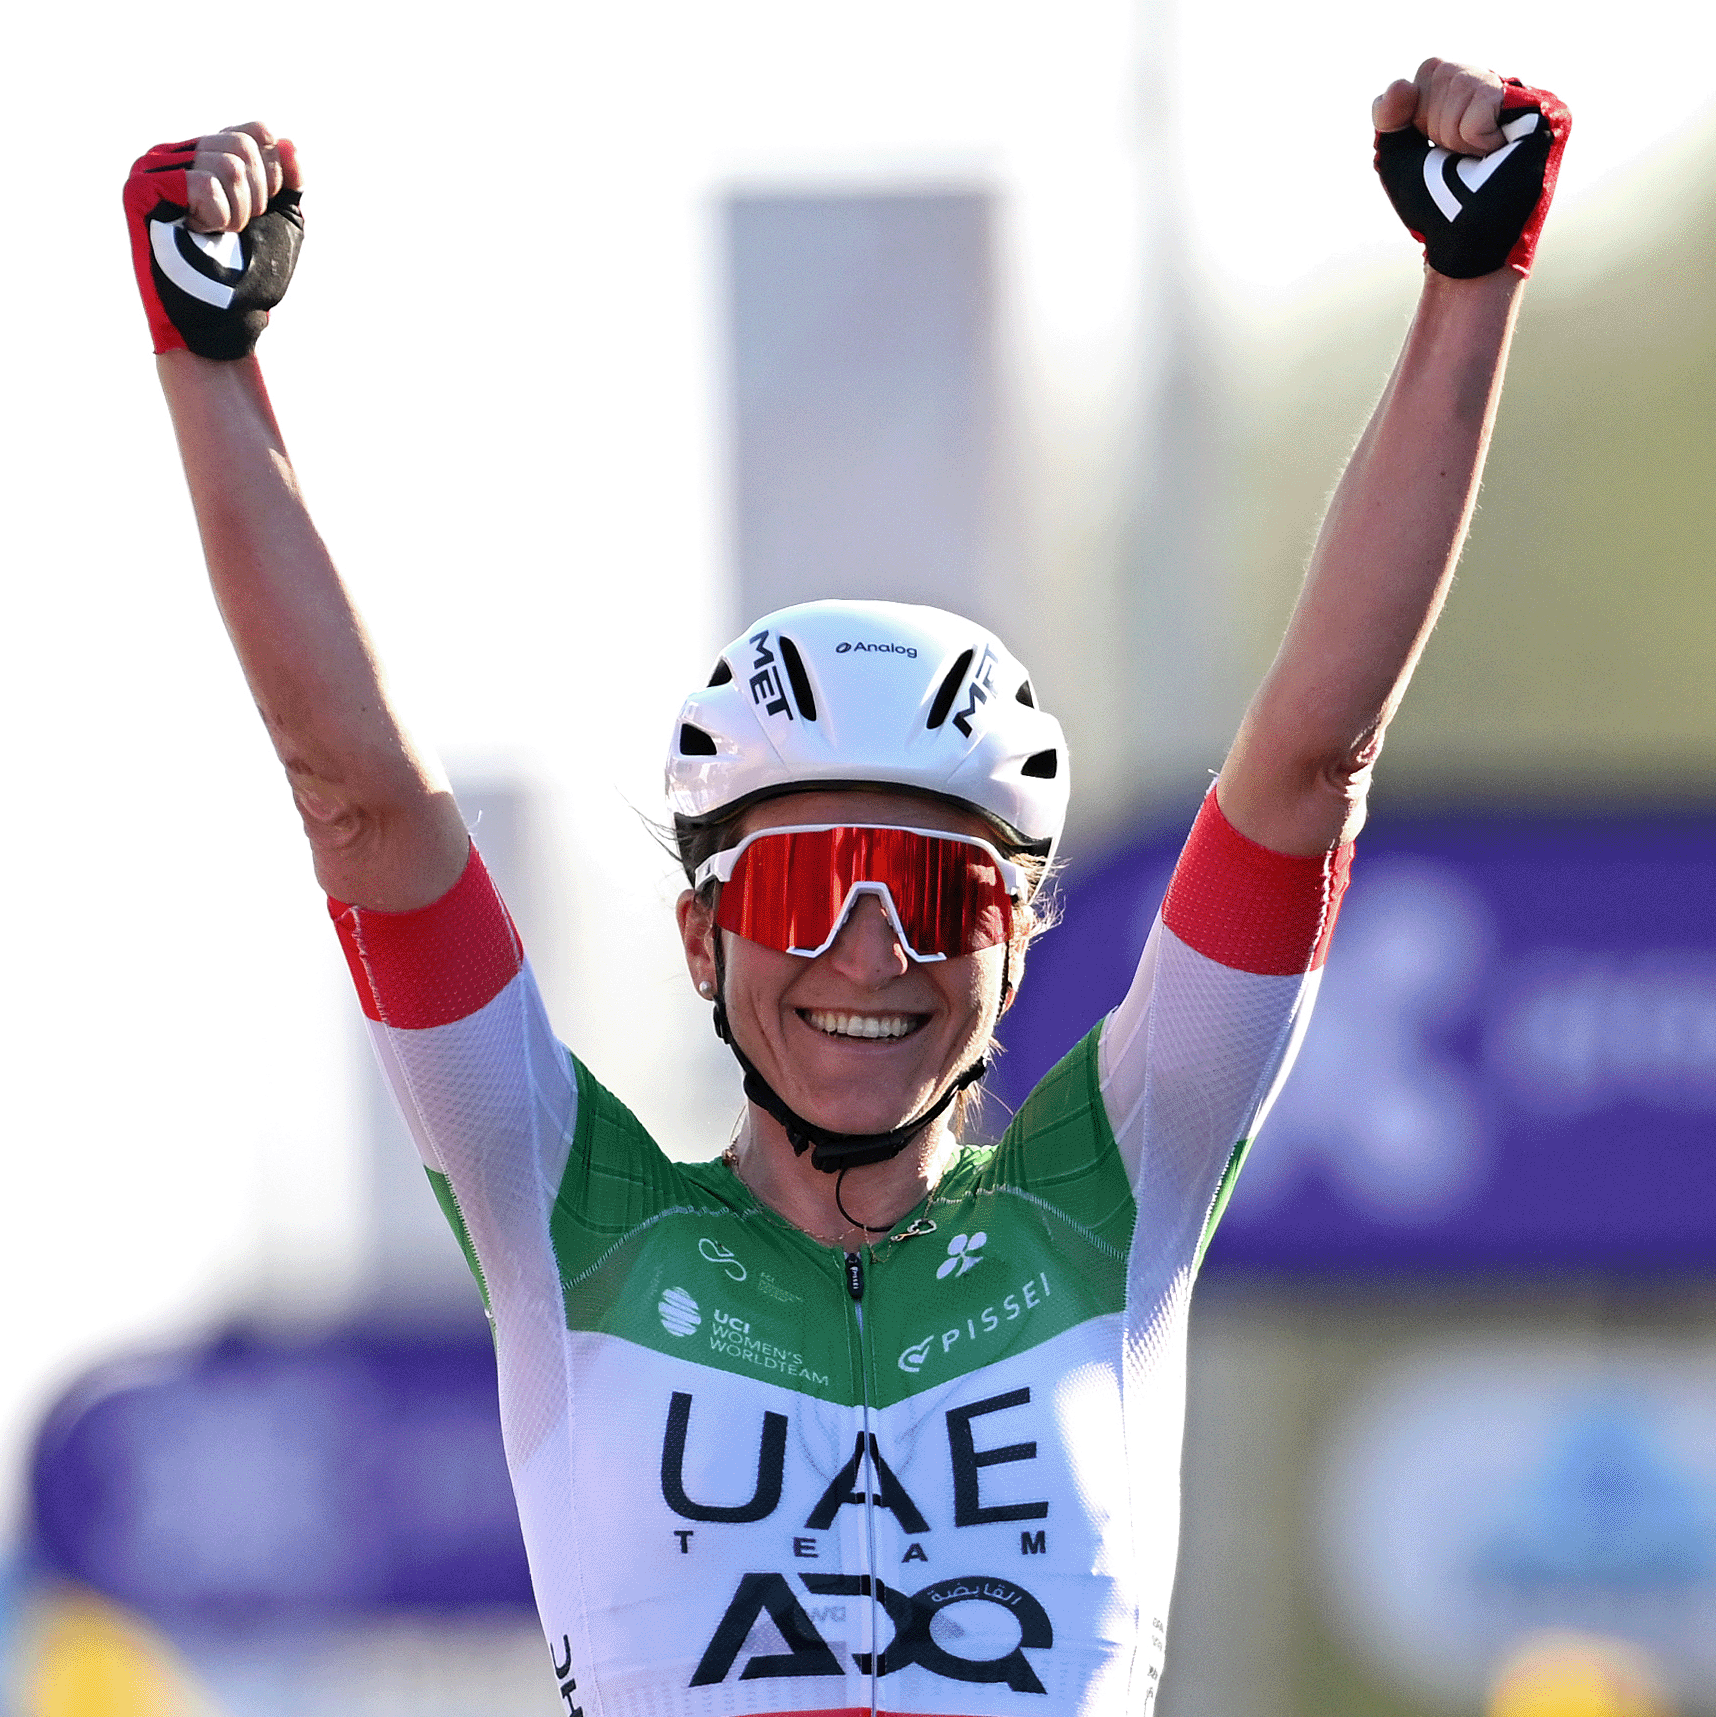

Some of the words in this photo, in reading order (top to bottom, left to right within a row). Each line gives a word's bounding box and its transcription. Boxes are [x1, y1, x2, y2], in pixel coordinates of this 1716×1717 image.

[853, 641, 918, 659] Analog
[749, 629, 794, 721] MET
[713, 1308, 751, 1334] UCI
[941, 1272, 1051, 1353] PISSEI
[709, 1336, 829, 1386] WORLDTEAM
[712, 1321, 804, 1365] WOMEN'S
[660, 1386, 1049, 1535] UAE
[673, 1530, 1047, 1564] TEAM
[926, 1582, 1023, 1606] القابضة
[688, 1572, 1054, 1695] ADQ
